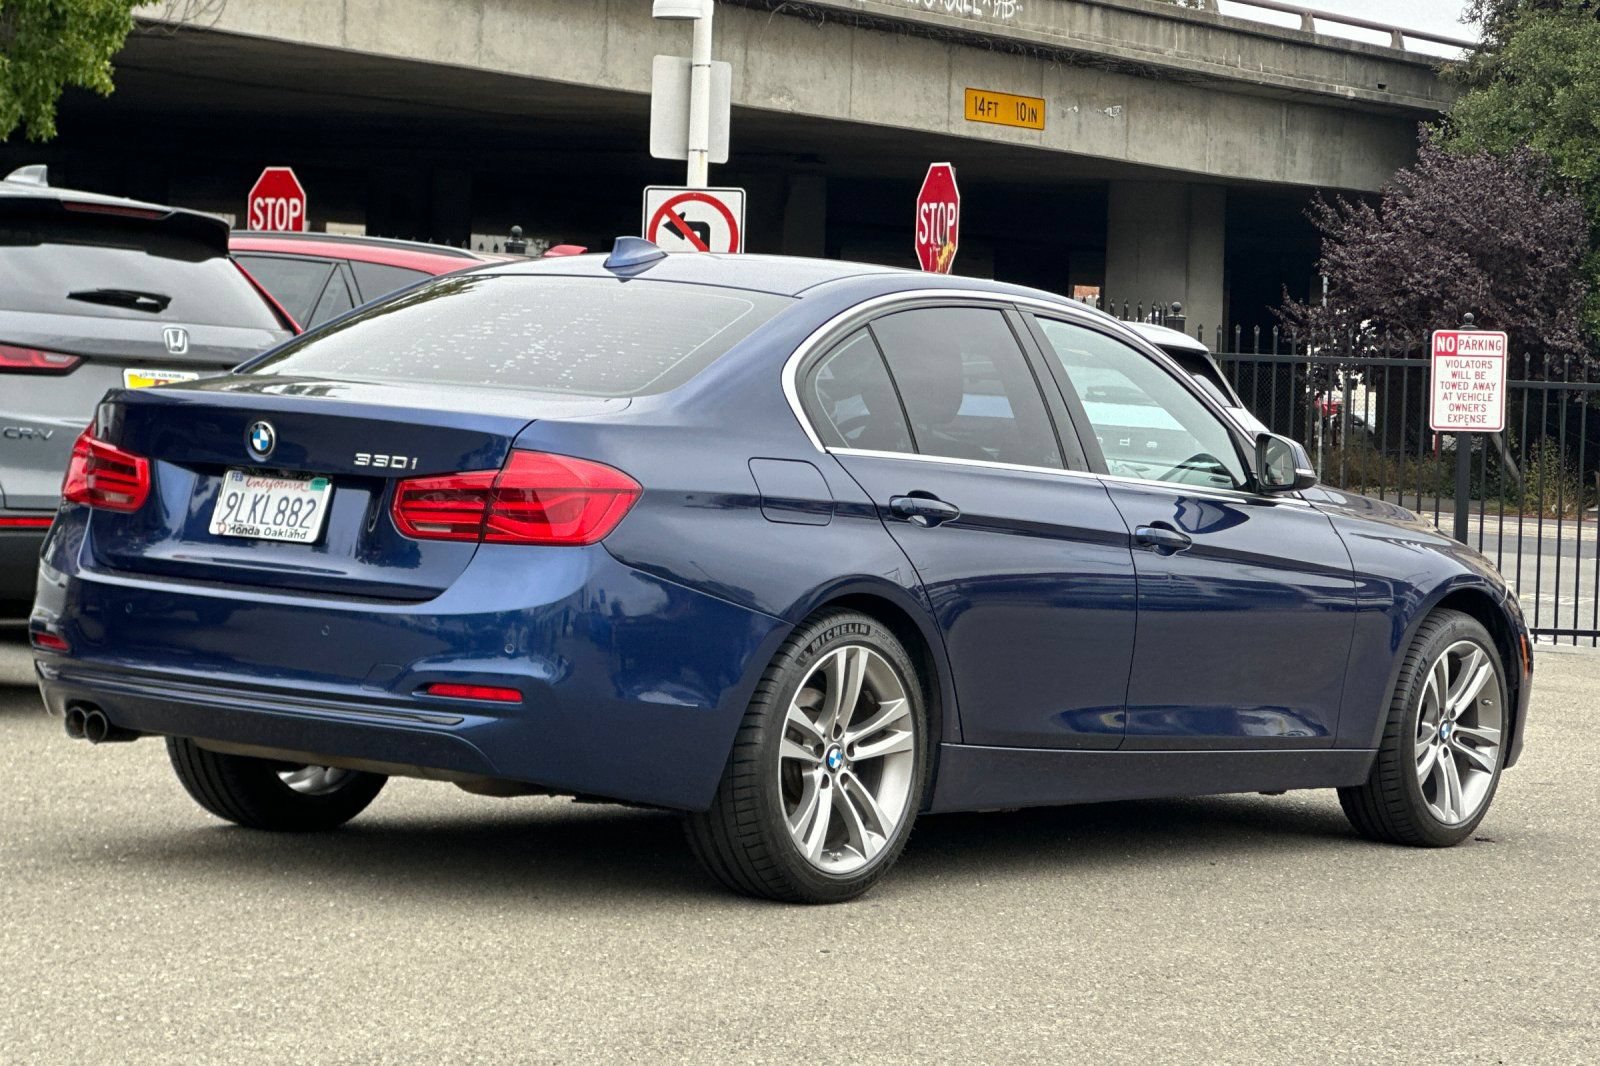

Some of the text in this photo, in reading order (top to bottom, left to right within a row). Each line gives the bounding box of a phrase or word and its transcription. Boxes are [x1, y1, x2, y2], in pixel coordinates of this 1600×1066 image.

[974, 96, 1038, 123] 14FT 10IN
[252, 197, 301, 230] STOP
[920, 202, 956, 245] STOP
[1437, 336, 1502, 352] NO PARKING
[1445, 360, 1493, 369] VIOLATORS
[1451, 371, 1486, 380] WILL BE
[1440, 381, 1497, 391] TOWED AWAY
[1442, 392, 1494, 402] AT VEHICLE
[1448, 403, 1487, 412] OWNER'S
[1448, 414, 1487, 423] EXPENSE
[3, 426, 53, 440] CR-V
[354, 453, 418, 470] 330i
[245, 475, 310, 493] California
[222, 491, 317, 529] 9LKL882
[228, 523, 308, 540] Honda Oakland
[811, 623, 869, 651] MICHELIN
